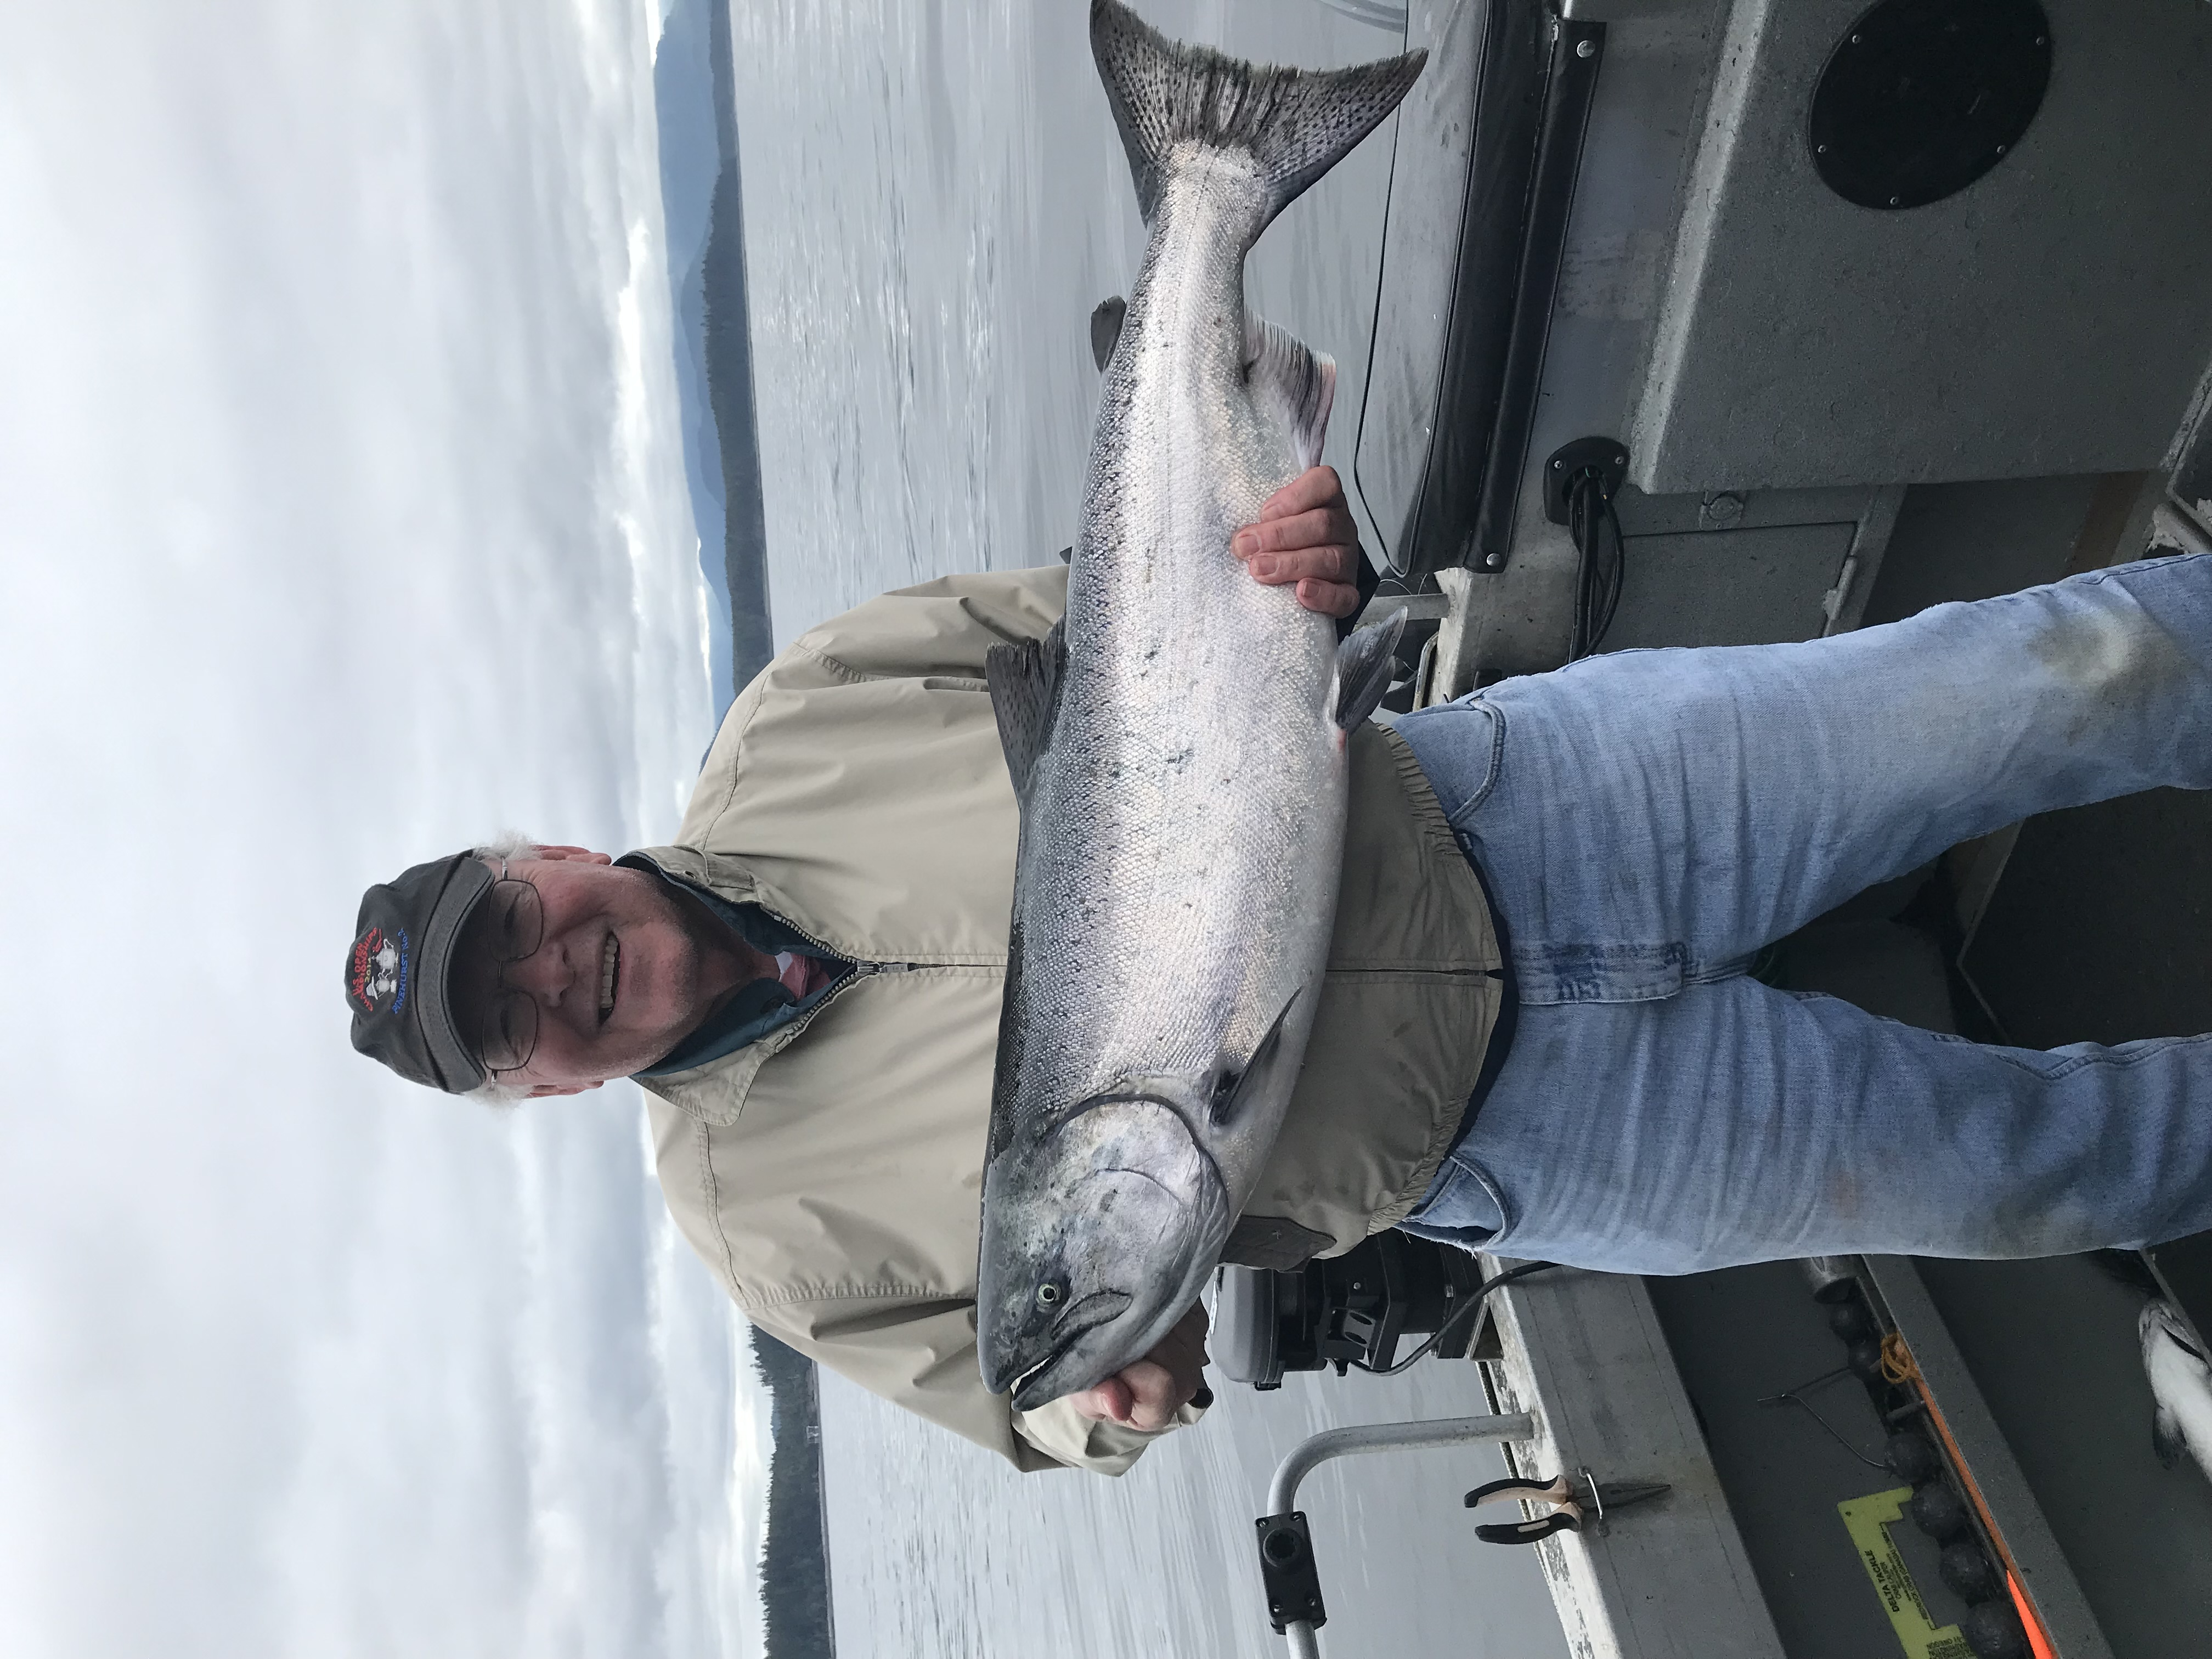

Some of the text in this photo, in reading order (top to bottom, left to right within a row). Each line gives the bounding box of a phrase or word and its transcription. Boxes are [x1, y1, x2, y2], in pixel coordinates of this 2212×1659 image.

[354, 943, 363, 973] OPEN
[392, 952, 408, 1014] PINEHURST
[1864, 1550, 1885, 1583] TACKLE
[1882, 1584, 1899, 1612] DELTA
